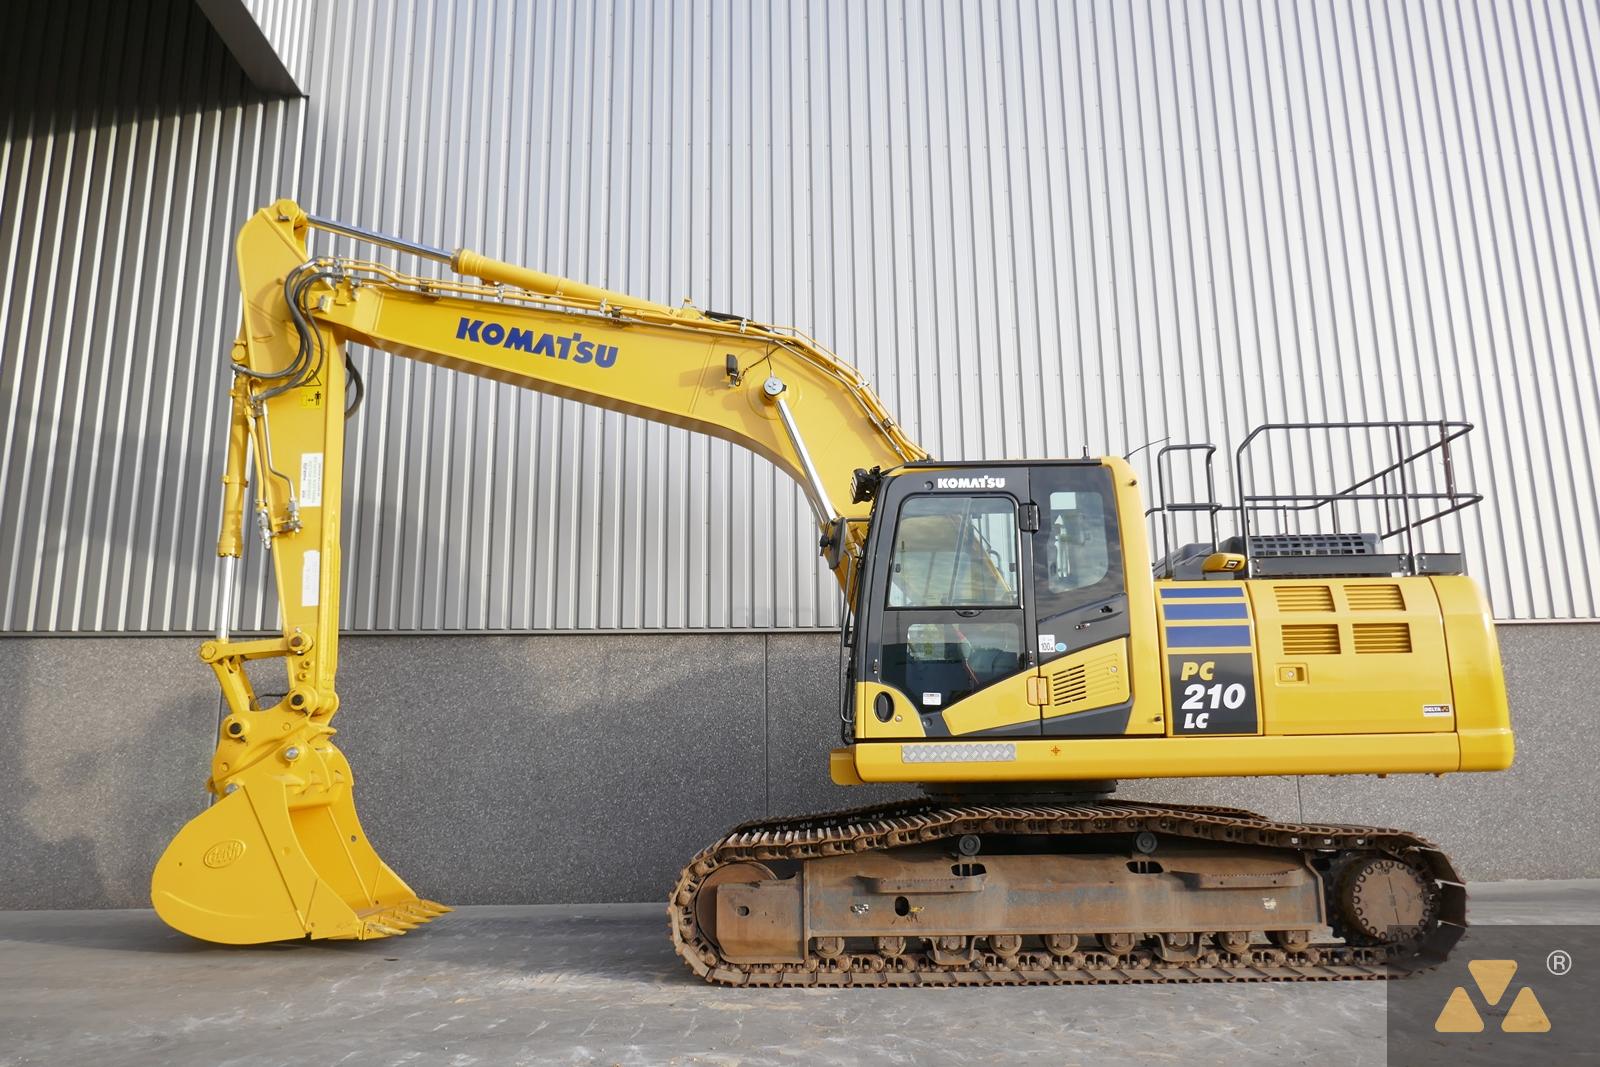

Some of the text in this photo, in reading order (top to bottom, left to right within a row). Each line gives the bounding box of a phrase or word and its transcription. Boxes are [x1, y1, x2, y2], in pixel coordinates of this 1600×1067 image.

[455, 316, 619, 369] KOMATSU
[937, 474, 1006, 489] KOMATSU
[1180, 661, 1216, 681] PC
[1181, 683, 1246, 710] 210
[1183, 712, 1210, 729] LC
